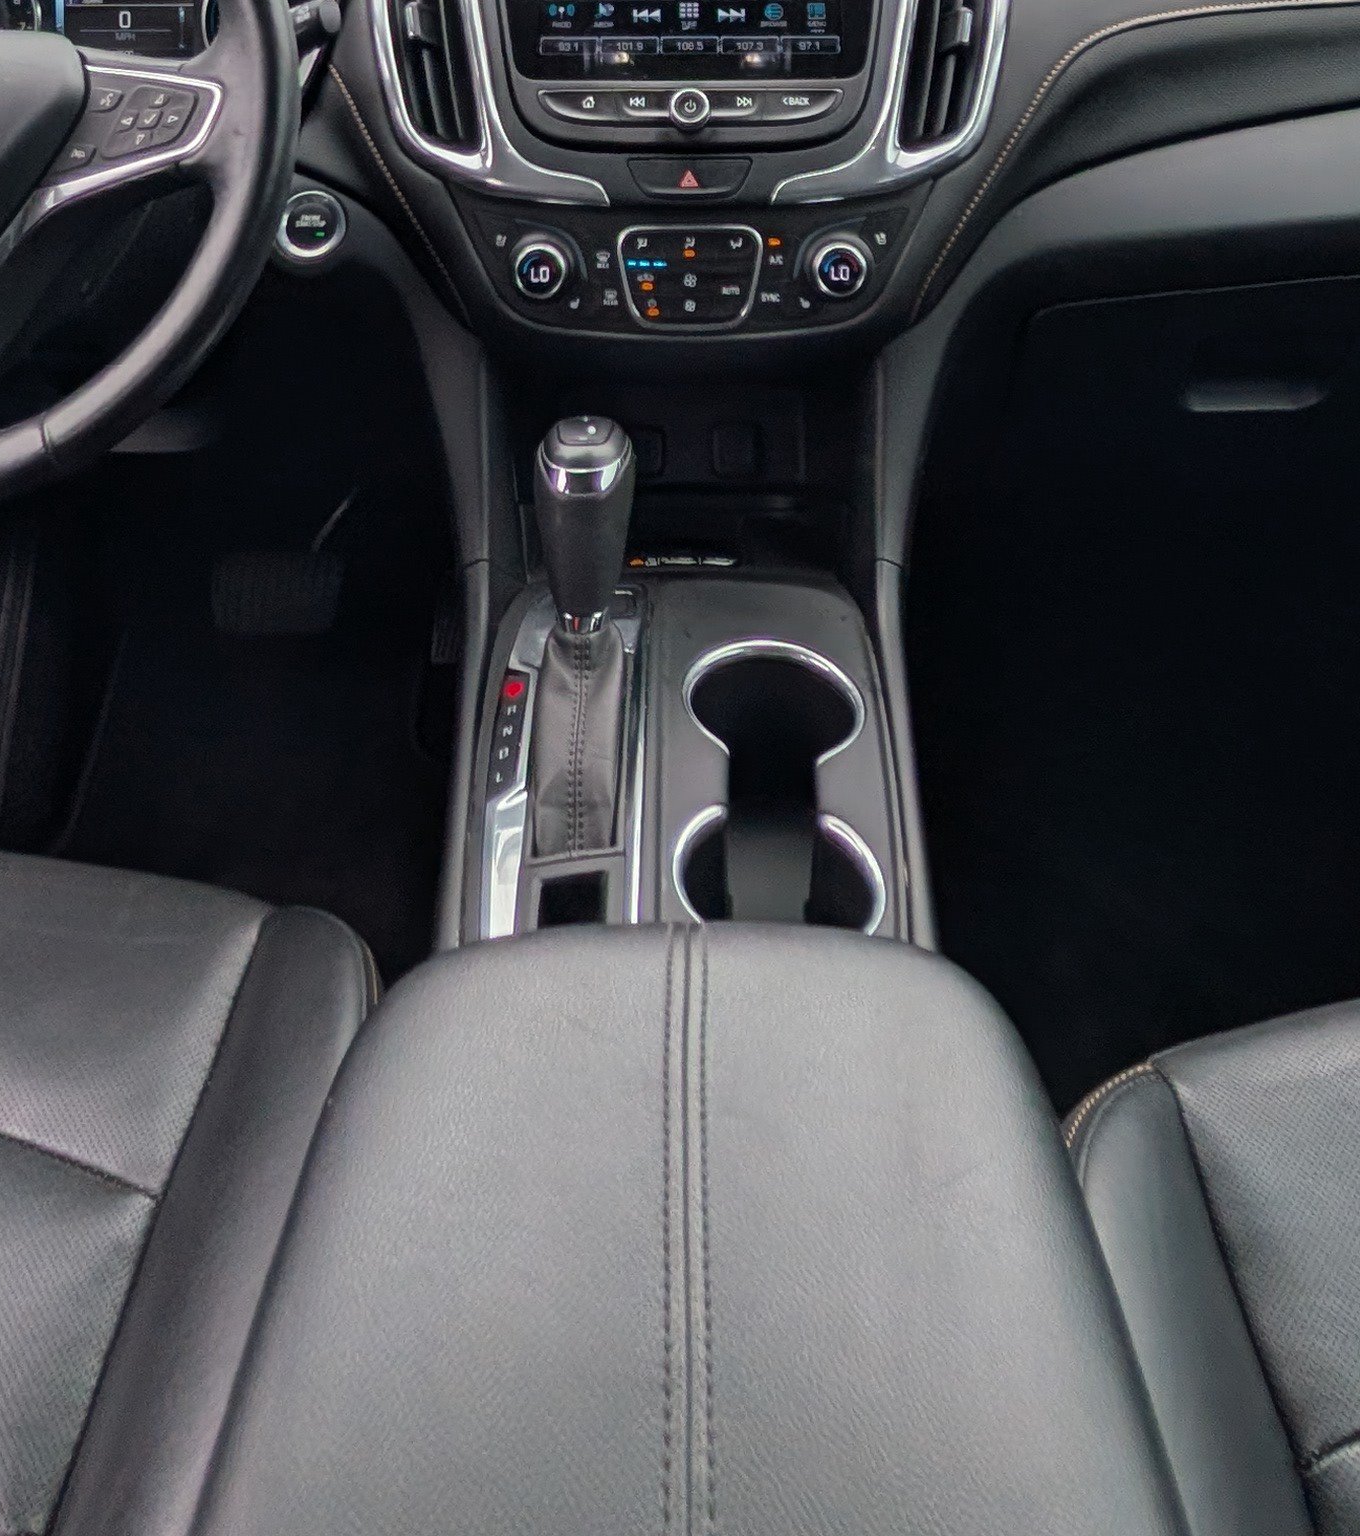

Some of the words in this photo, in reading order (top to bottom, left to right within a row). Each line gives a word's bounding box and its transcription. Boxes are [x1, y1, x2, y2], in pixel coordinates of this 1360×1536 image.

[119, 11, 131, 29] 0
[616, 41, 645, 52] 101.9
[735, 40, 765, 52] 107.3
[797, 40, 821, 52] 97.1
[788, 96, 811, 106] BACK
[768, 254, 784, 266] A/C
[529, 265, 551, 283] LO
[829, 264, 850, 282] LO
[760, 292, 781, 303] SYNC
